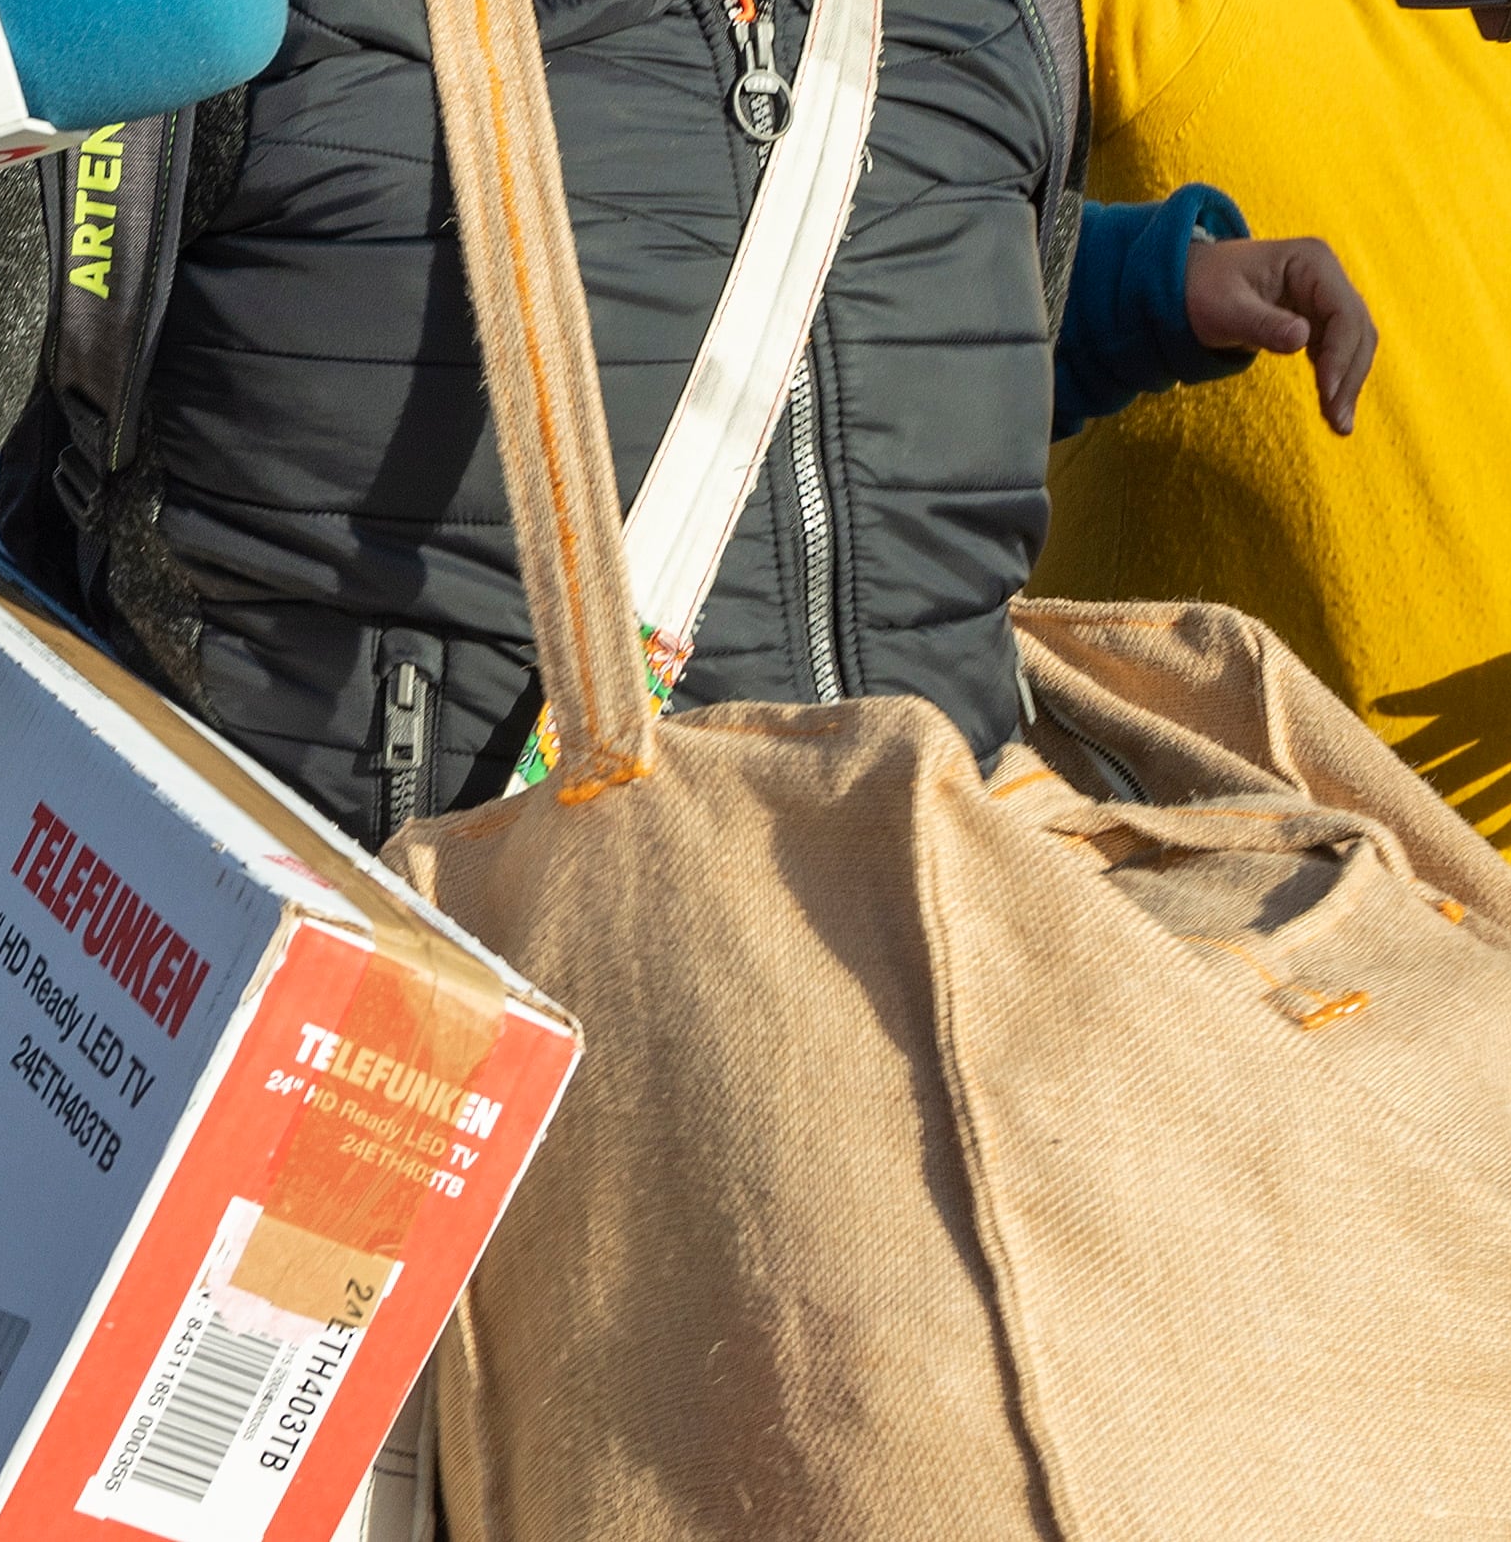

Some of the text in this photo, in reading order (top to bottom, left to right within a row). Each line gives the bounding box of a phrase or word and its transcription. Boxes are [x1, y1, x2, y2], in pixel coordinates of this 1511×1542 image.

[11, 800, 211, 1040] TELEFUNKEN
[23, 958, 85, 1042] Ready
[79, 1016, 126, 1080] LED
[119, 1058, 156, 1109] TV
[296, 1022, 503, 1141] TELEFUNKEN
[10, 1034, 122, 1173] 24ETH403TB
[265, 1069, 478, 1168] 24" HD Ready LED TV
[340, 1134, 466, 1199] 24ETH403TB
[105, 1317, 203, 1492] 8431185 000355
